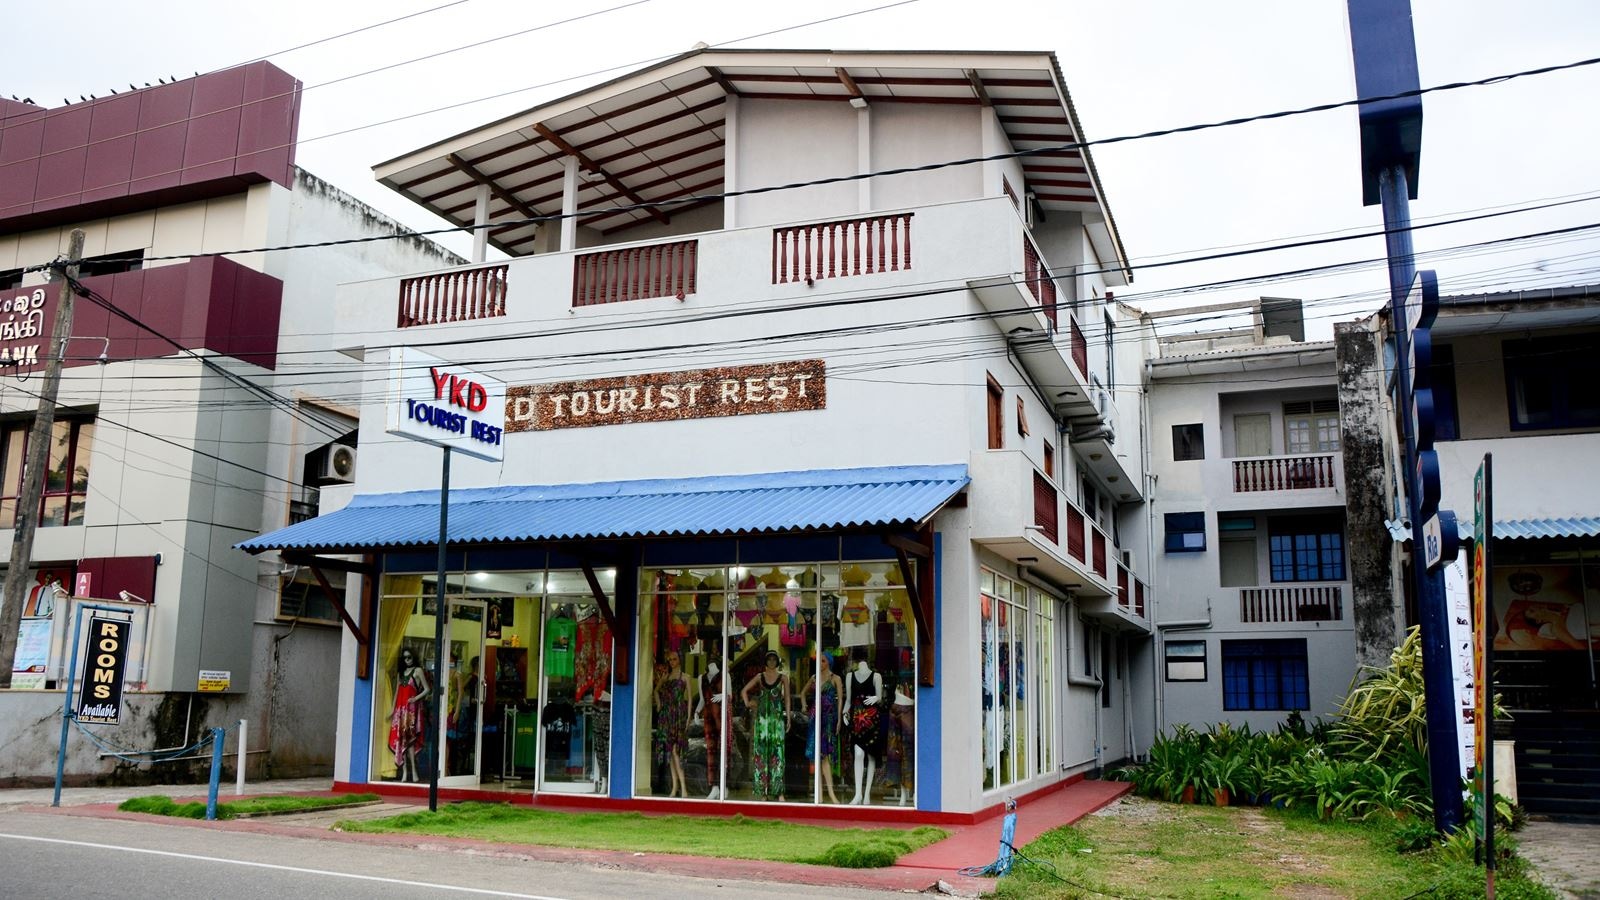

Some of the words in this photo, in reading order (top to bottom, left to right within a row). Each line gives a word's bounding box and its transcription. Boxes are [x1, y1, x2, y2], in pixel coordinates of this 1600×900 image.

[430, 367, 487, 412] YKD
[549, 384, 702, 419] TOURIST
[721, 373, 812, 404] REST
[407, 399, 467, 434] TOURIST
[471, 420, 502, 445] REST
[1427, 535, 1439, 563] Ria
[93, 623, 118, 699] ROOMS
[1475, 546, 1483, 768] AYURVEDA
[81, 703, 117, 718] Available
